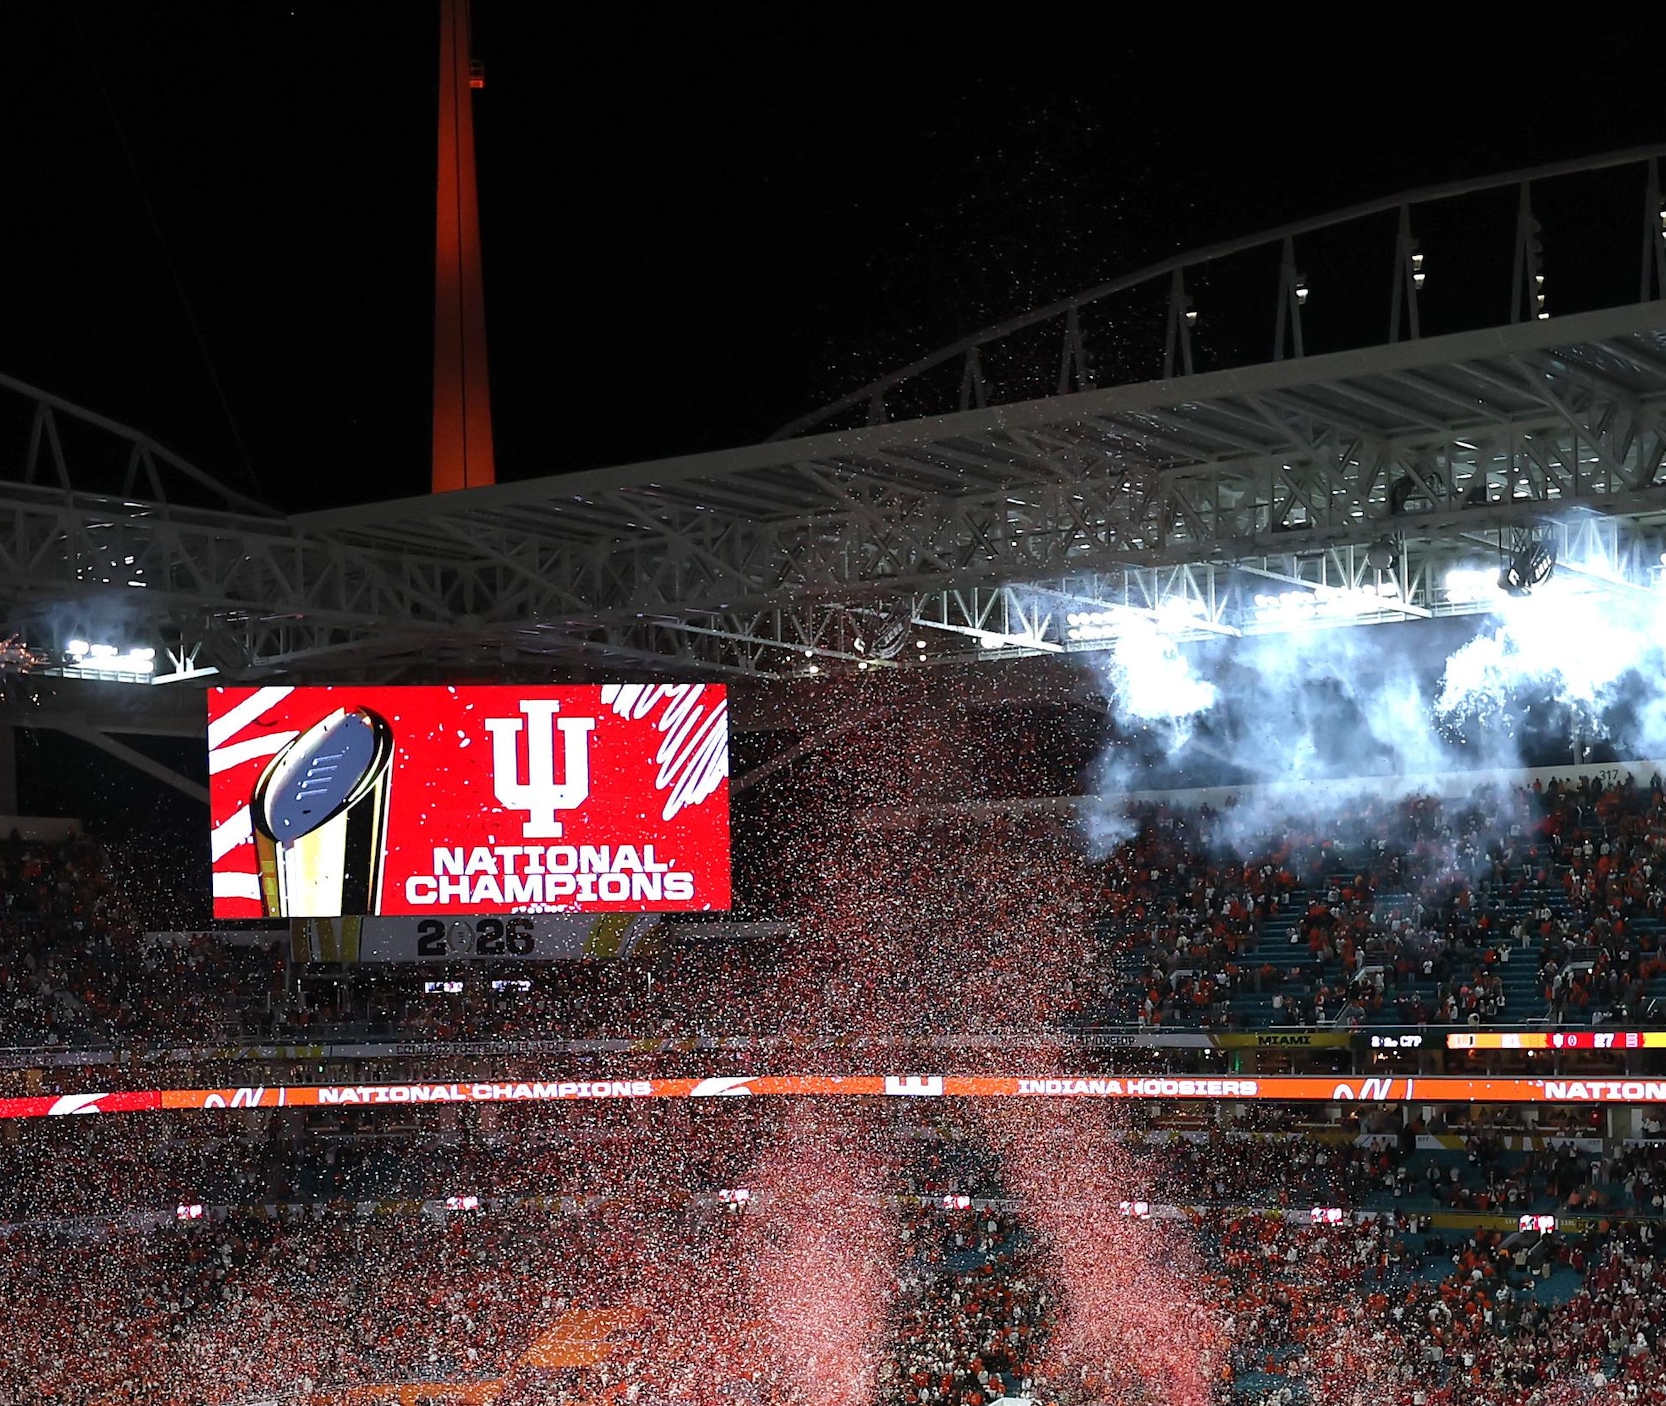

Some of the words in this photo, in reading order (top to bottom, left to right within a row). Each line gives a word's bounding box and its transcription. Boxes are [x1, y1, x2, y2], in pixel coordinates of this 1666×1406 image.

[433, 844, 669, 876] NATIONAL
[405, 871, 694, 905] CHAMPIONS
[1258, 1035, 1311, 1046] MIAMI
[318, 1084, 466, 1104] NATIONAL
[471, 1081, 652, 1101] CHAMPIONS
[1019, 1079, 1121, 1095] INDIANA
[1127, 1079, 1258, 1096] HOOSIERS
